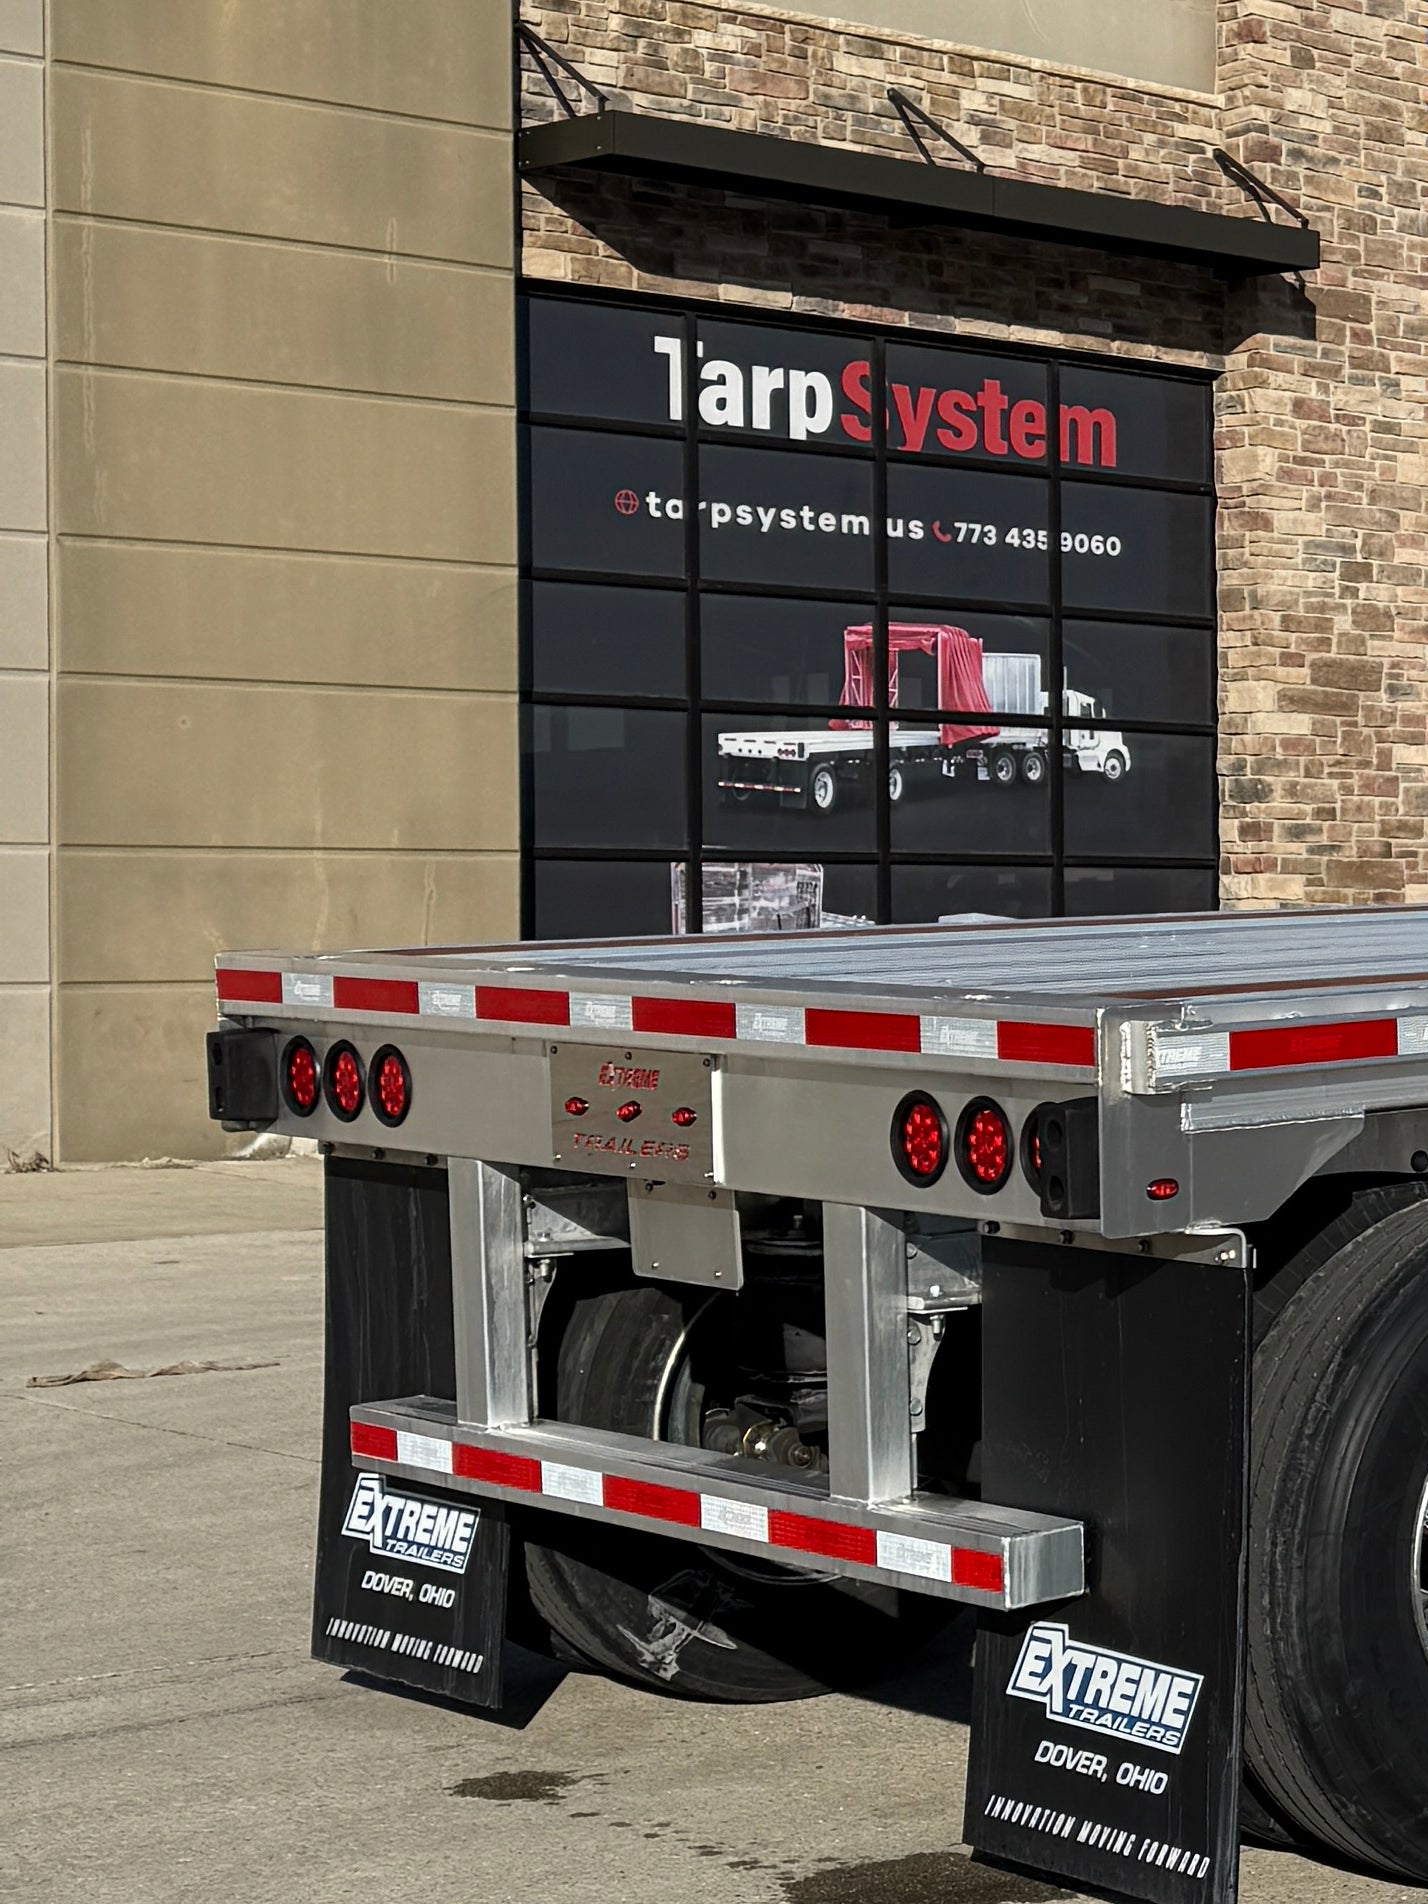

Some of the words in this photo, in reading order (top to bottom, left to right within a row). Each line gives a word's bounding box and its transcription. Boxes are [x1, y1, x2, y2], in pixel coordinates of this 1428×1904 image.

[653, 335, 1117, 468] TarpSystem
[953, 521, 997, 546] 773
[1004, 527, 1048, 551] 435
[1060, 532, 1123, 557] 9060
[572, 1132, 691, 1160] TRAILERS
[348, 1478, 475, 1553] EXTREME
[385, 1538, 465, 1568] TRAILERS
[361, 1570, 414, 1602] DOVER,
[418, 1583, 456, 1609] OHIO
[1016, 1628, 1196, 1729] EXTREME
[1068, 1703, 1181, 1745] TRAILERS
[1034, 1740, 1108, 1782] DOVER,
[1116, 1762, 1169, 1795] OHIO
[984, 1794, 1077, 1839] INNOVATION
[1076, 1819, 1137, 1857] MOVING
[1137, 1838, 1211, 1879] FORWARD
